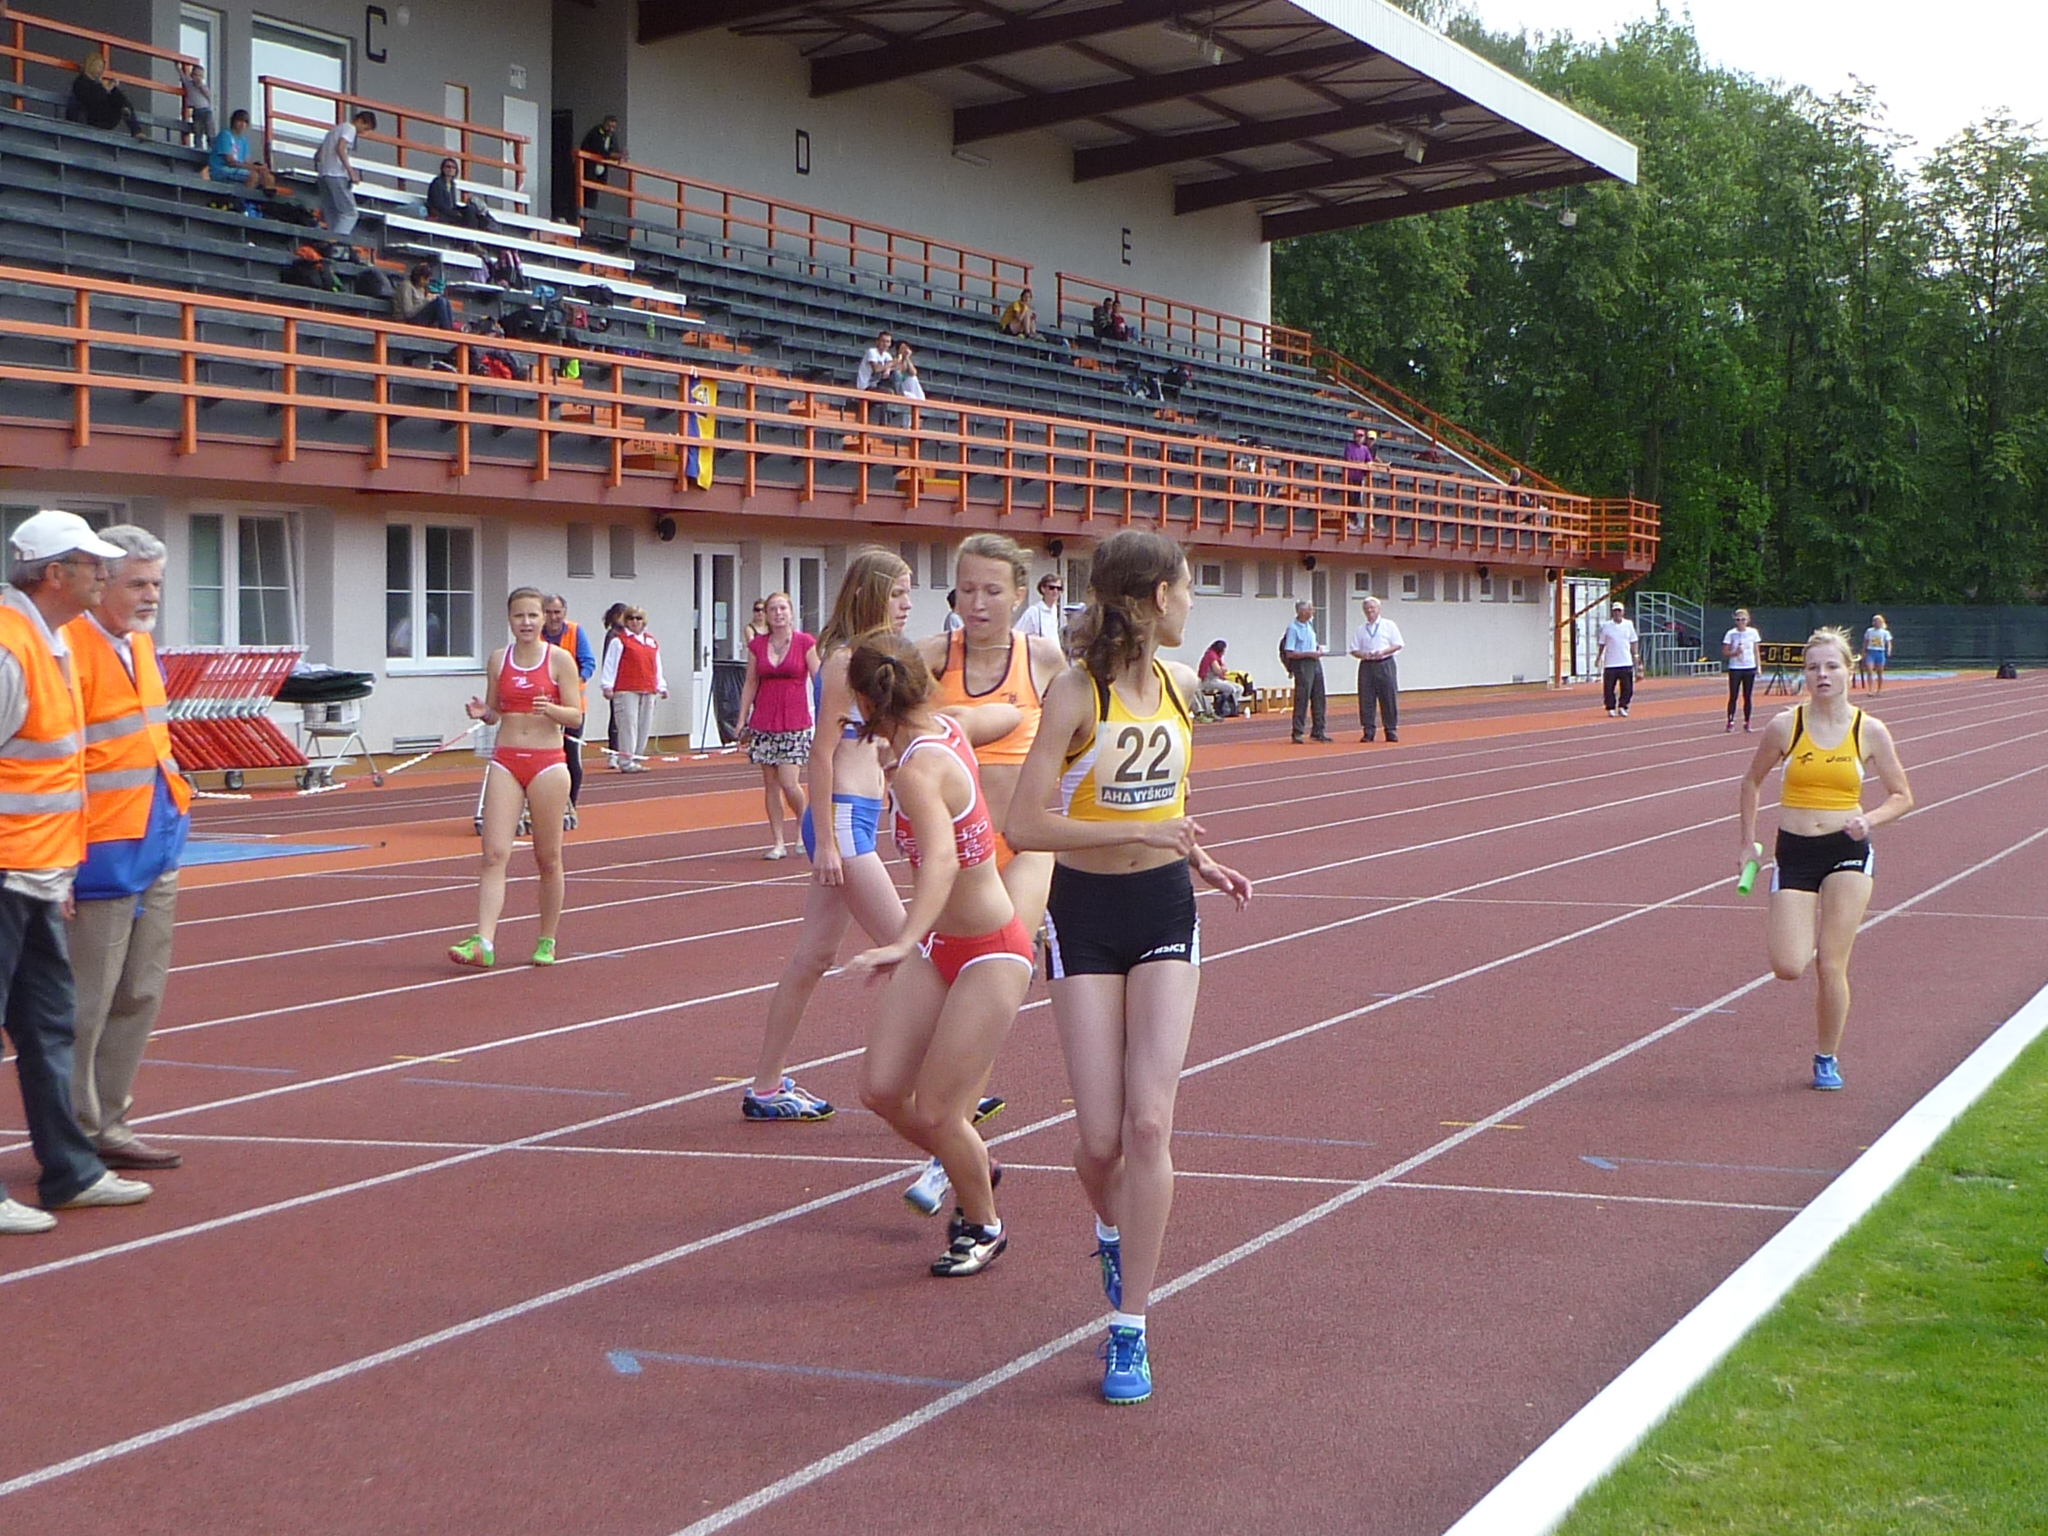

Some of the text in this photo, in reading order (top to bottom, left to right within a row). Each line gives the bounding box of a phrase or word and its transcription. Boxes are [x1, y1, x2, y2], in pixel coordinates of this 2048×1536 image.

[366, 5, 387, 63] C
[796, 128, 810, 176] D
[1122, 227, 1131, 266] E
[1114, 725, 1172, 782] 22
[1103, 785, 1176, 803] AHA VYŠKOV
